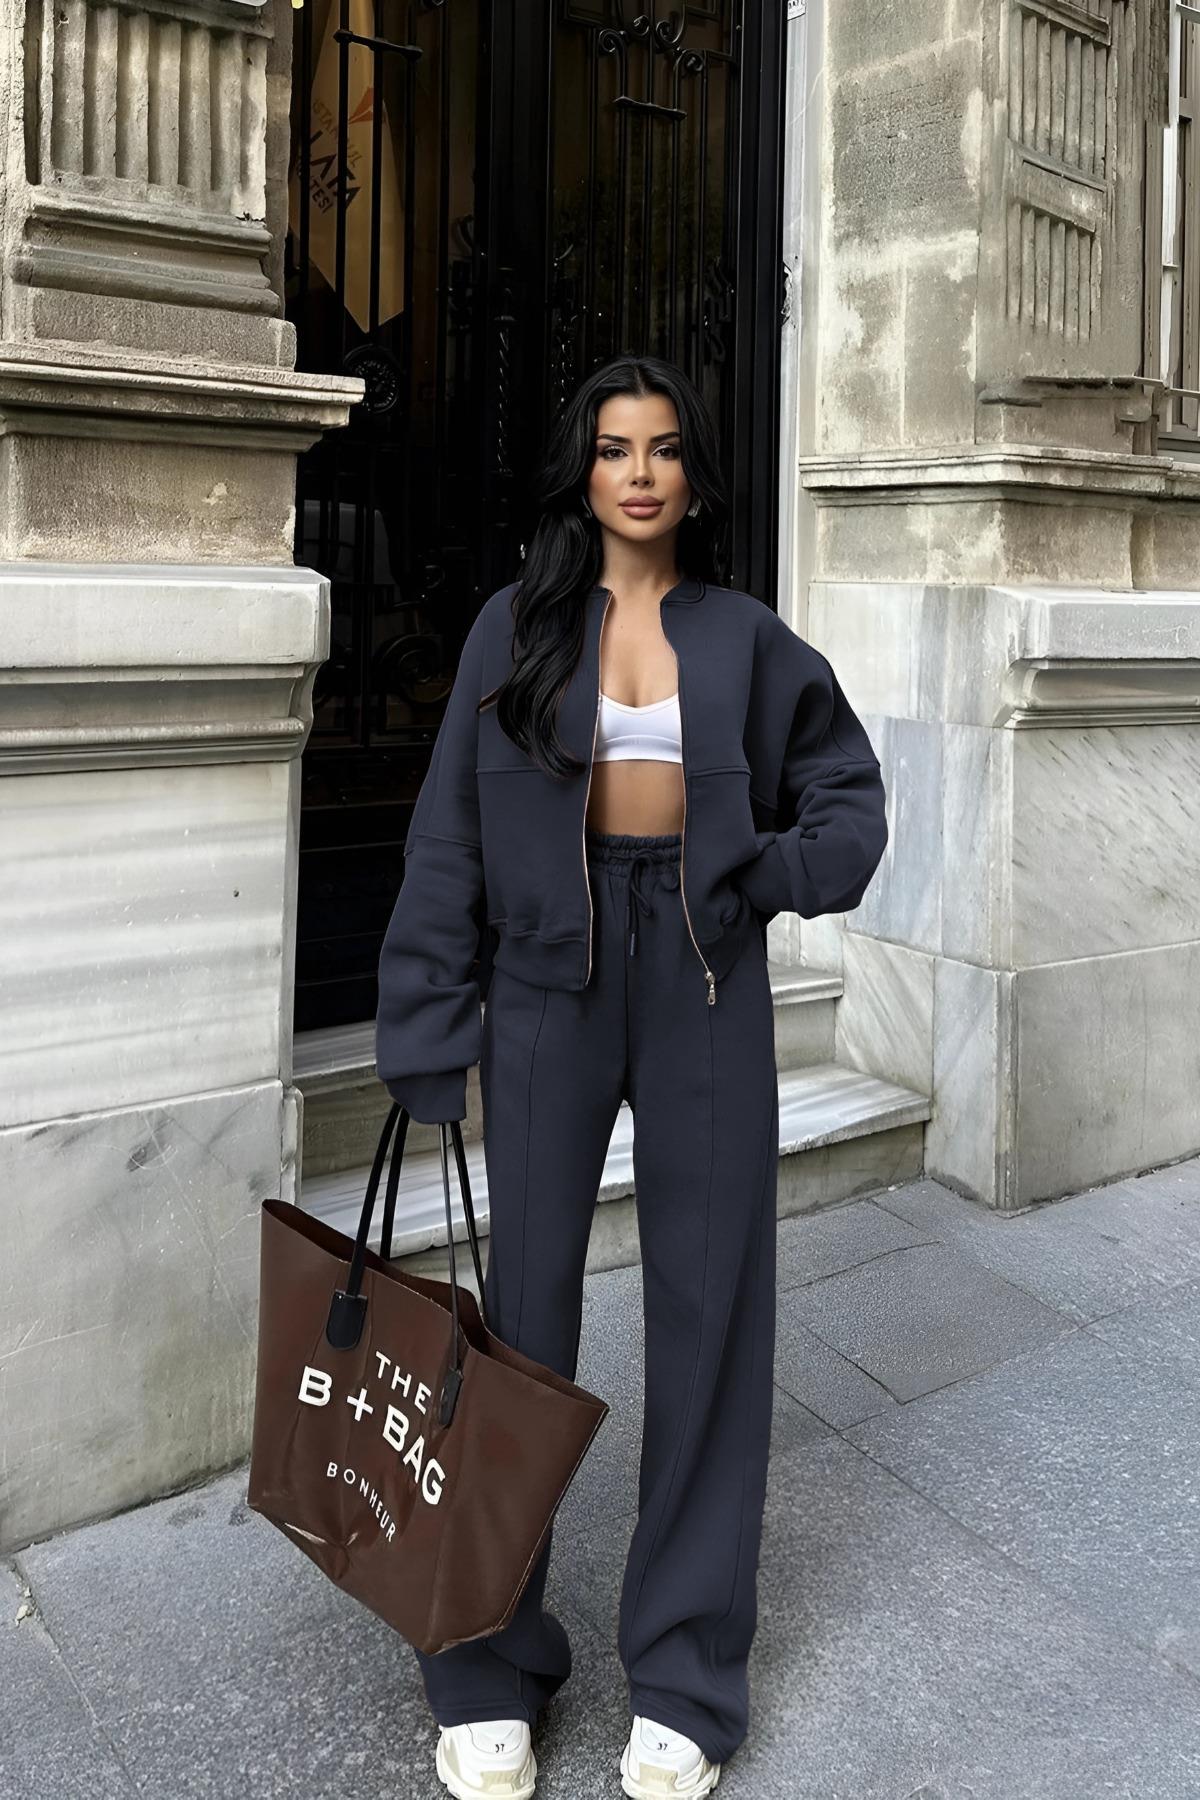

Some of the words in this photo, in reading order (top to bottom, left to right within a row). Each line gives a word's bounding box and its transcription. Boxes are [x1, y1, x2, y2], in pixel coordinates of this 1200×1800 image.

[374, 1351, 432, 1415] THE
[298, 1365, 333, 1407] B
[382, 1404, 446, 1505] BAG
[326, 1461, 396, 1542] BONHEUR
